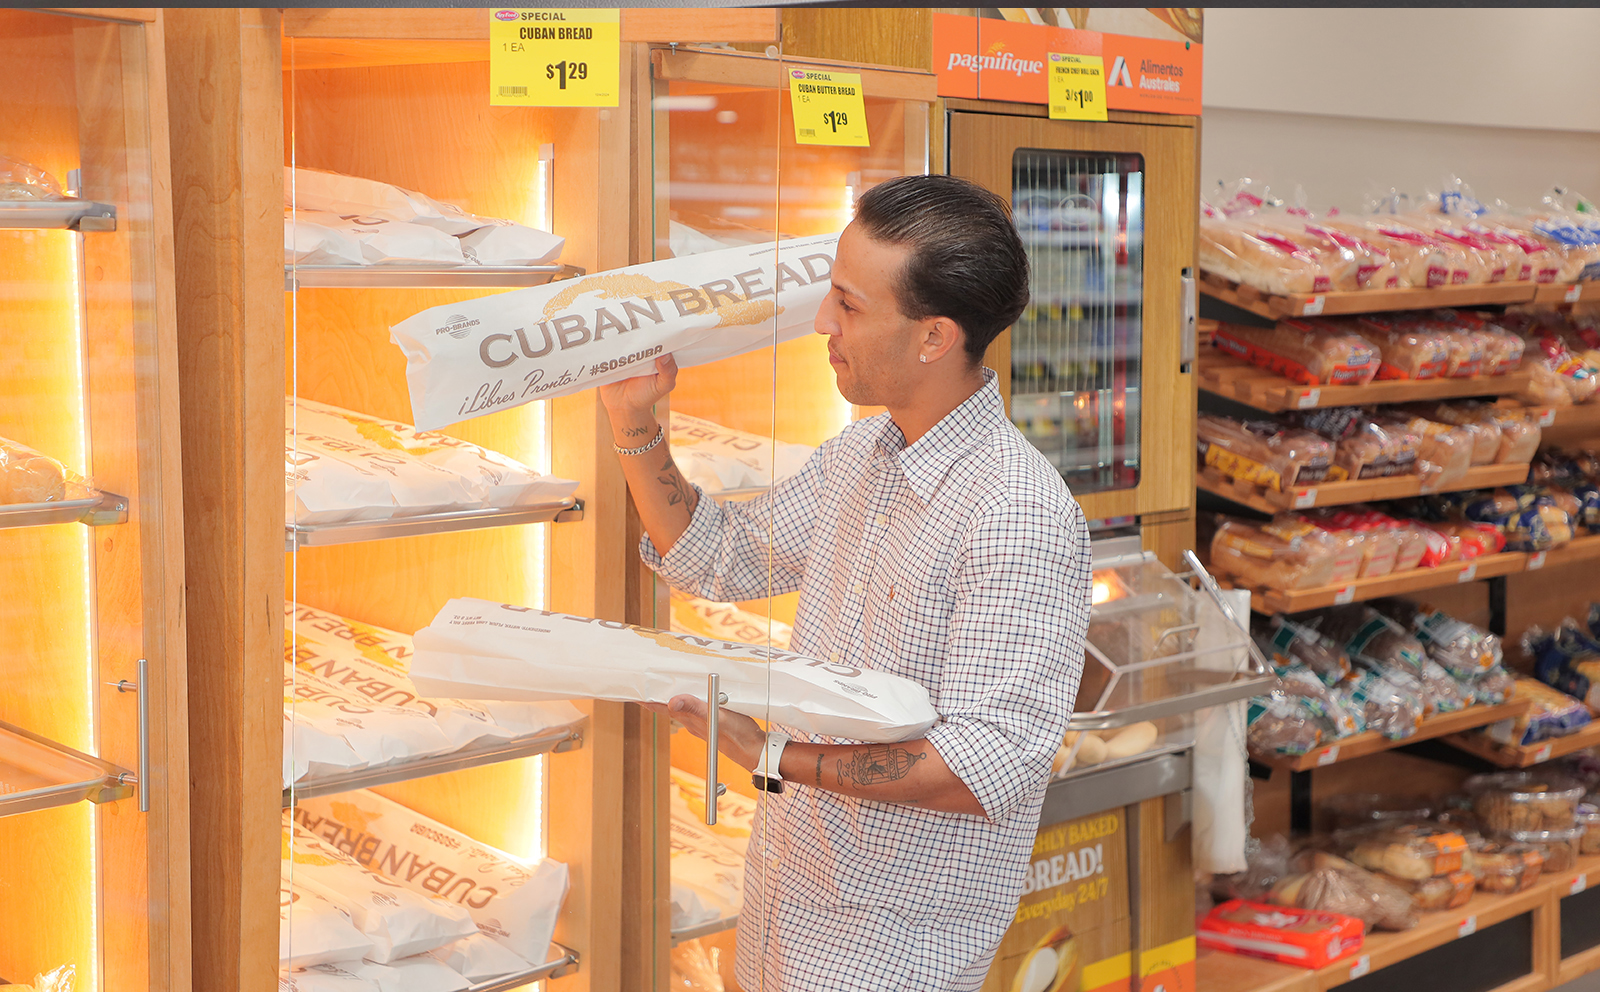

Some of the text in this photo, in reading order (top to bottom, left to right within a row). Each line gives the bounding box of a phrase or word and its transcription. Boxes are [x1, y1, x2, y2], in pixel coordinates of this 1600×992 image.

[521, 12, 566, 21] SPECIAL
[519, 27, 593, 40] CUBAN BREAD
[503, 43, 526, 52] 1 EA
[947, 51, 1044, 77] pagnifique
[1140, 59, 1184, 77] Alimentos
[806, 73, 832, 82] SPECIAL
[1139, 74, 1180, 93] Australes
[798, 84, 856, 96] CUBAN BUTTER BREAD
[802, 95, 811, 103] EA
[479, 252, 836, 370] CUBAN BREAD
[435, 319, 481, 335] PRO-BRANDS
[521, 365, 585, 398] Pronto!
[589, 344, 663, 377] #SOSCUBA
[1068, 814, 1119, 846] BAKED
[377, 842, 499, 910] CUBAN
[1021, 843, 1104, 897] BREAD!
[1015, 876, 1109, 924] Everyday 24/7
